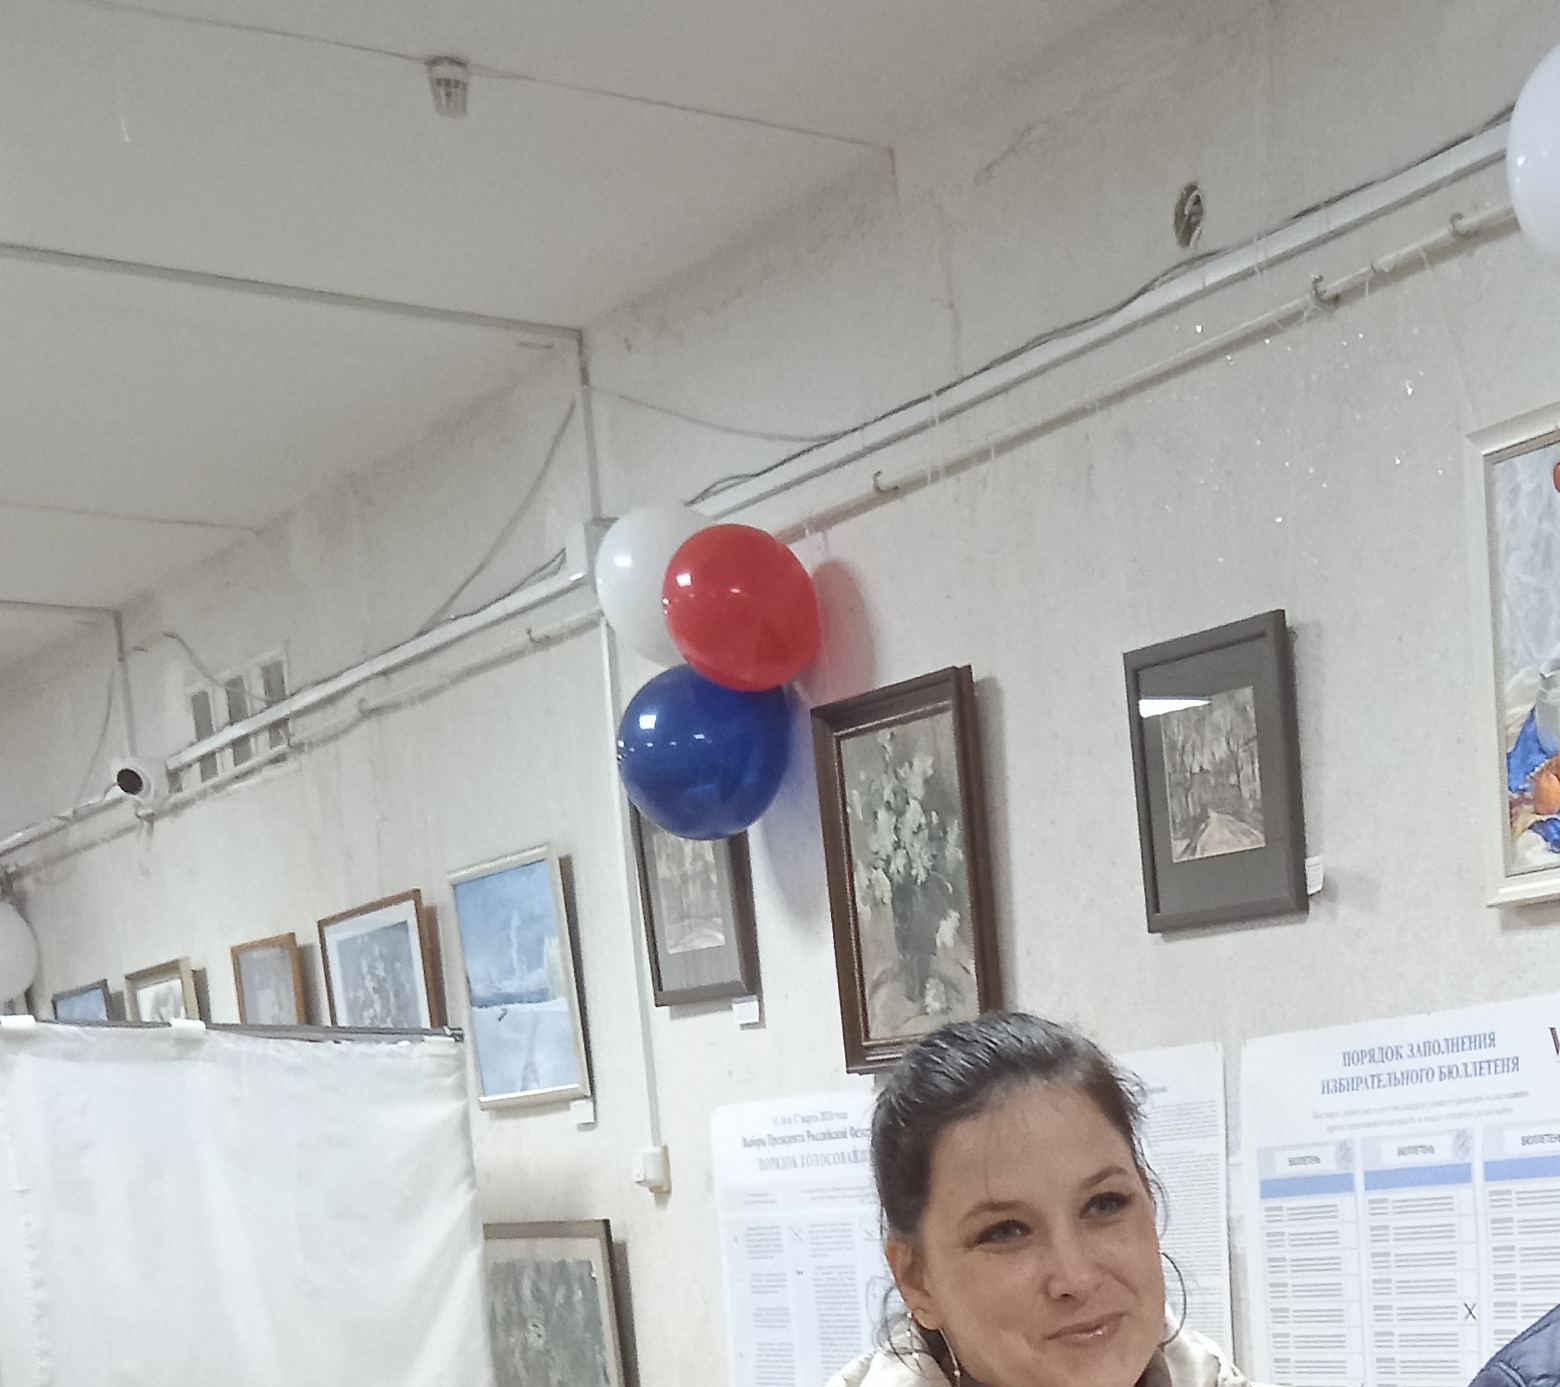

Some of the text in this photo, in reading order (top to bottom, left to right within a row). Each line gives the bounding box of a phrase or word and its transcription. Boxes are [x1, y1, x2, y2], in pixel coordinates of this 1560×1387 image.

[1341, 1031, 1497, 1068] ПОРЯДОК ЗАПОЛНЕНИЯ
[1320, 1056, 1521, 1095] ИЗБИРАТЕЛЬНОГО БЮЛЛЕТЕНЯ
